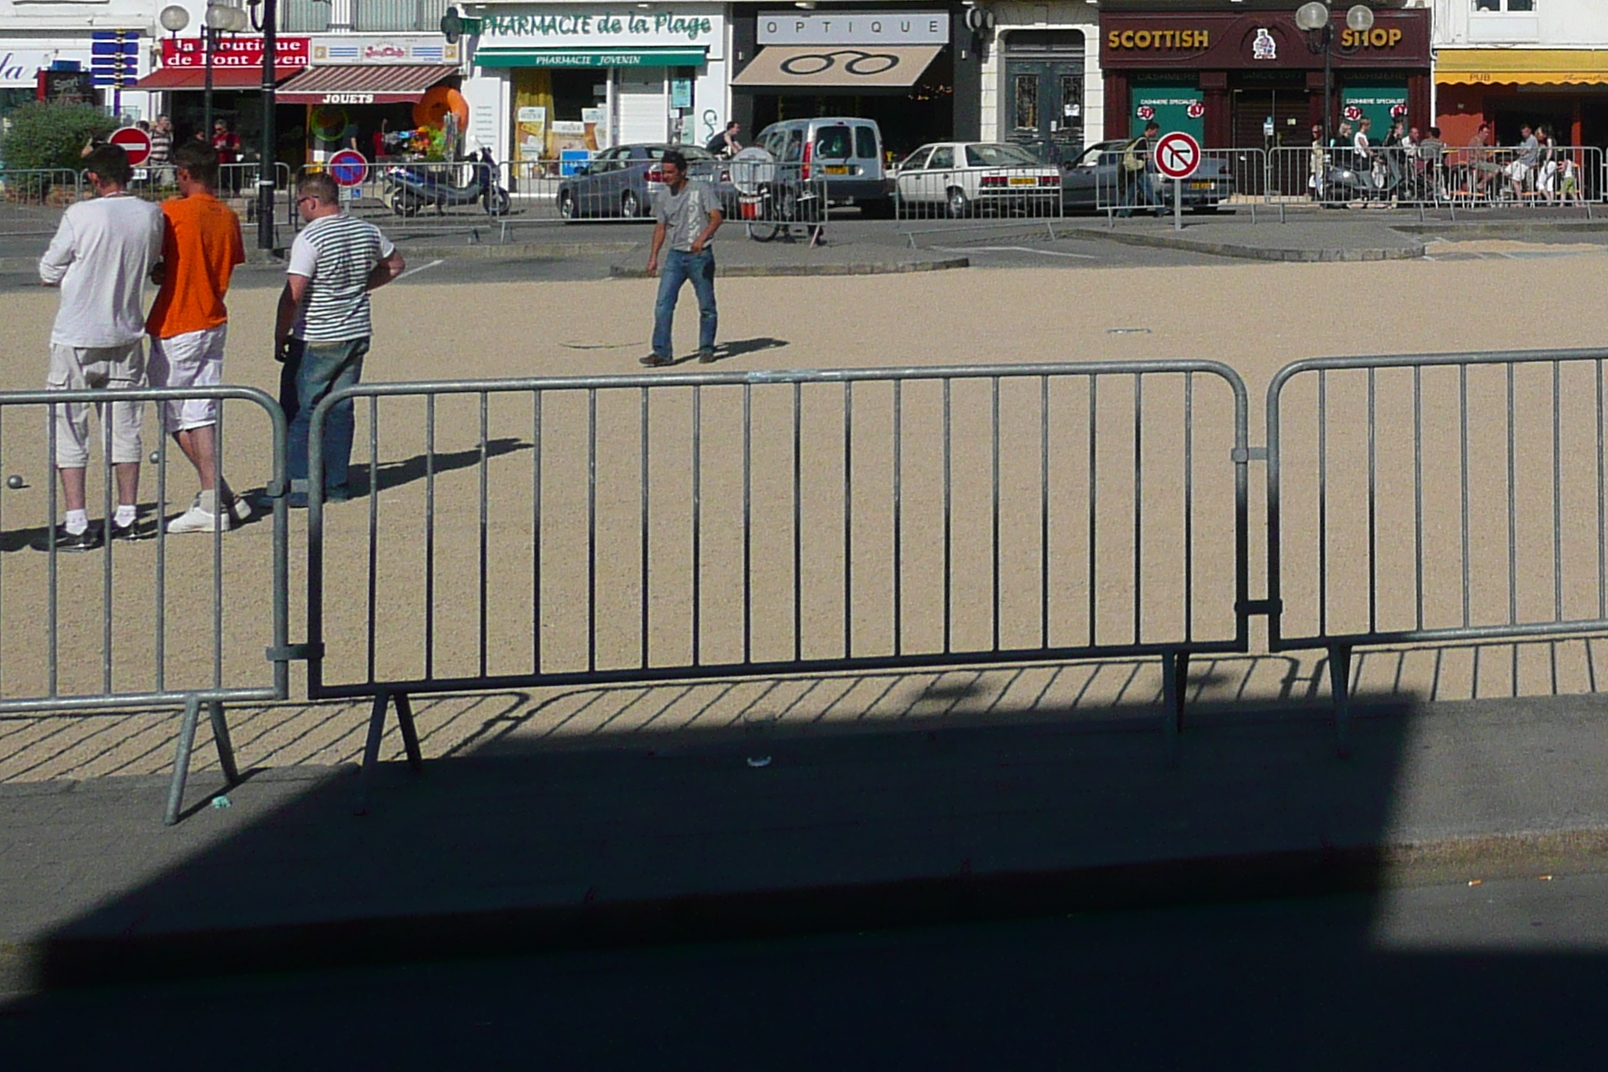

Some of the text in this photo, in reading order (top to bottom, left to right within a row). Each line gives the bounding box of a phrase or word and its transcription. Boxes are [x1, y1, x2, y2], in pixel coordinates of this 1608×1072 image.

[481, 11, 711, 40] PHARMACIE de la Plage
[767, 20, 939, 34] OPTIQUE
[1108, 28, 1402, 49] SCOTTISH SHOP
[167, 53, 192, 66] de
[536, 57, 590, 65] PHARMACIE
[322, 94, 374, 104] JOUETS
